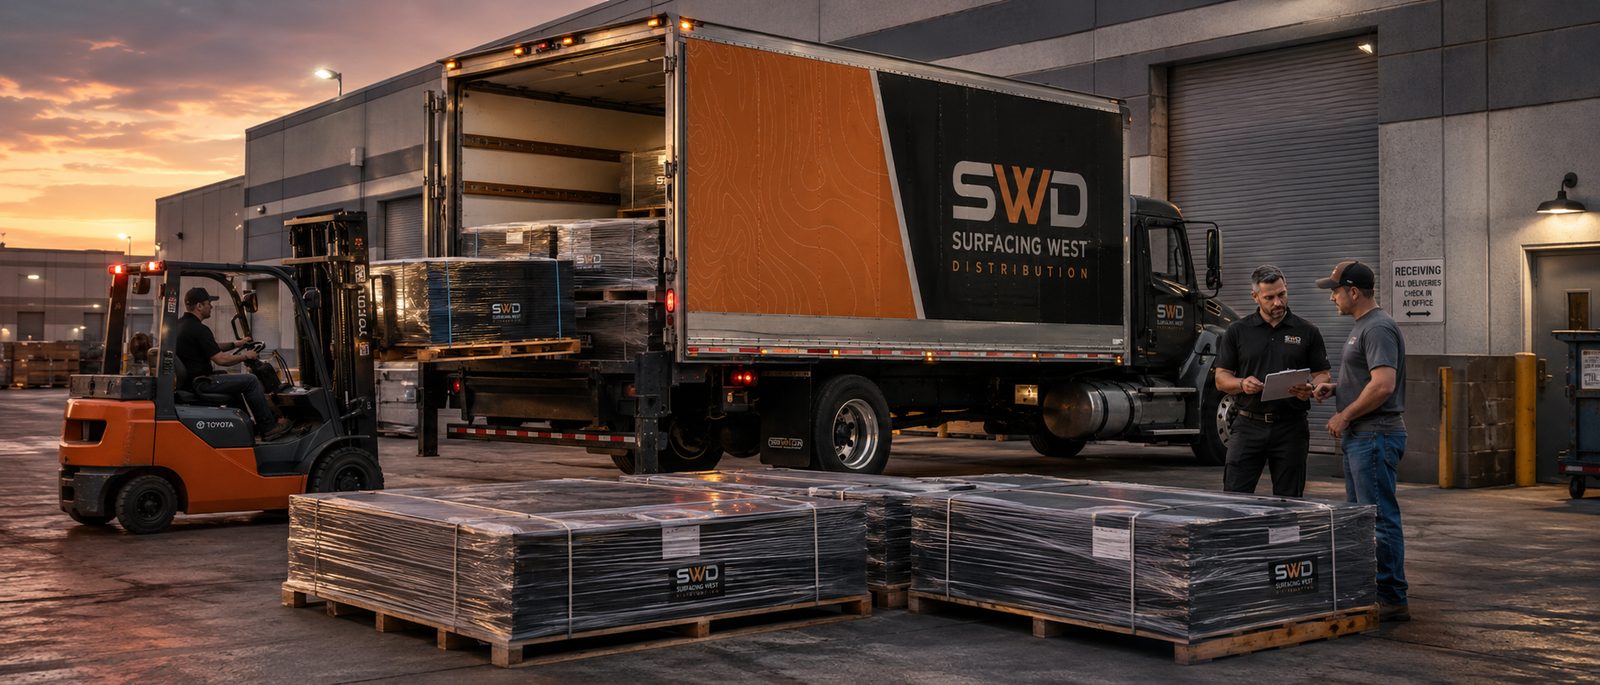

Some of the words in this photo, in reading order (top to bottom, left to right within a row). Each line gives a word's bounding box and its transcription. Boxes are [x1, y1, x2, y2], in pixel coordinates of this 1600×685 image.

[952, 160, 1088, 229] SWD
[952, 231, 1042, 256] SURFACING
[1047, 238, 1088, 258] WEST
[952, 260, 1088, 279] DISTRIBUTION
[1395, 266, 1441, 276] RECEIVING
[492, 302, 521, 315] SWD
[1156, 304, 1184, 319] SWD
[206, 421, 234, 429] TOYOTA
[676, 564, 719, 584] SWD
[1275, 560, 1313, 580] SWD
